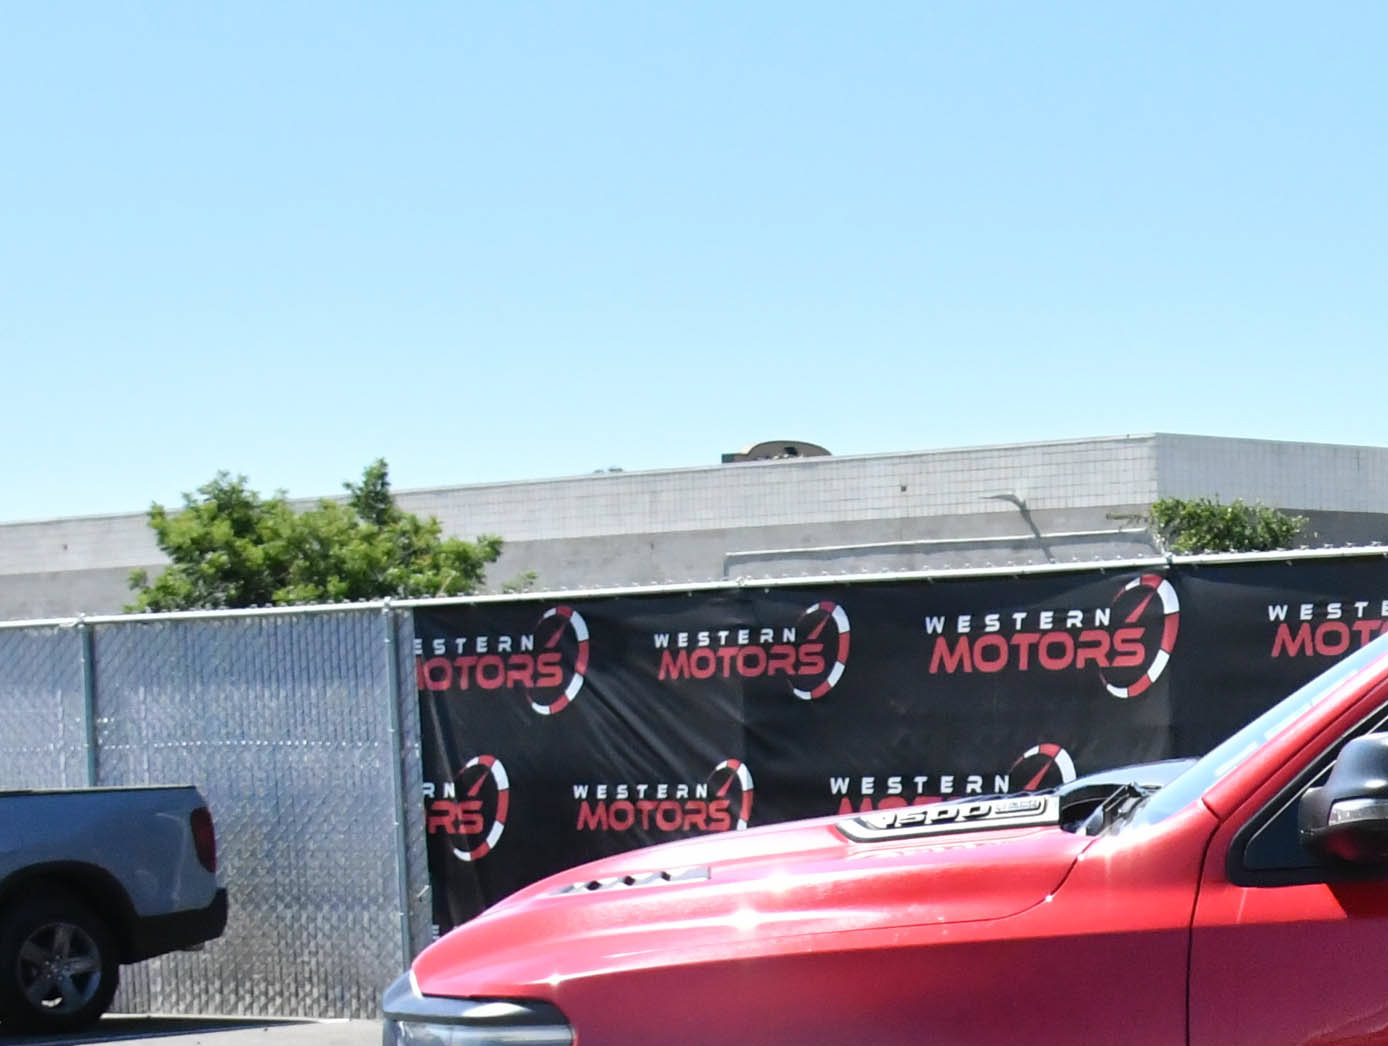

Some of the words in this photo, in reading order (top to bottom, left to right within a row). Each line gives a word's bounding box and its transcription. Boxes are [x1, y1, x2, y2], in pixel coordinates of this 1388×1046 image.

[925, 607, 1111, 634] WESTERN
[414, 634, 534, 654] ESTERN
[654, 627, 797, 649] WESTERN
[658, 643, 826, 680] MOTORS
[929, 627, 1146, 674] MOTORS
[573, 784, 708, 799] WESTERN
[830, 775, 1009, 795] WESTERN
[576, 800, 731, 831] MOTORS
